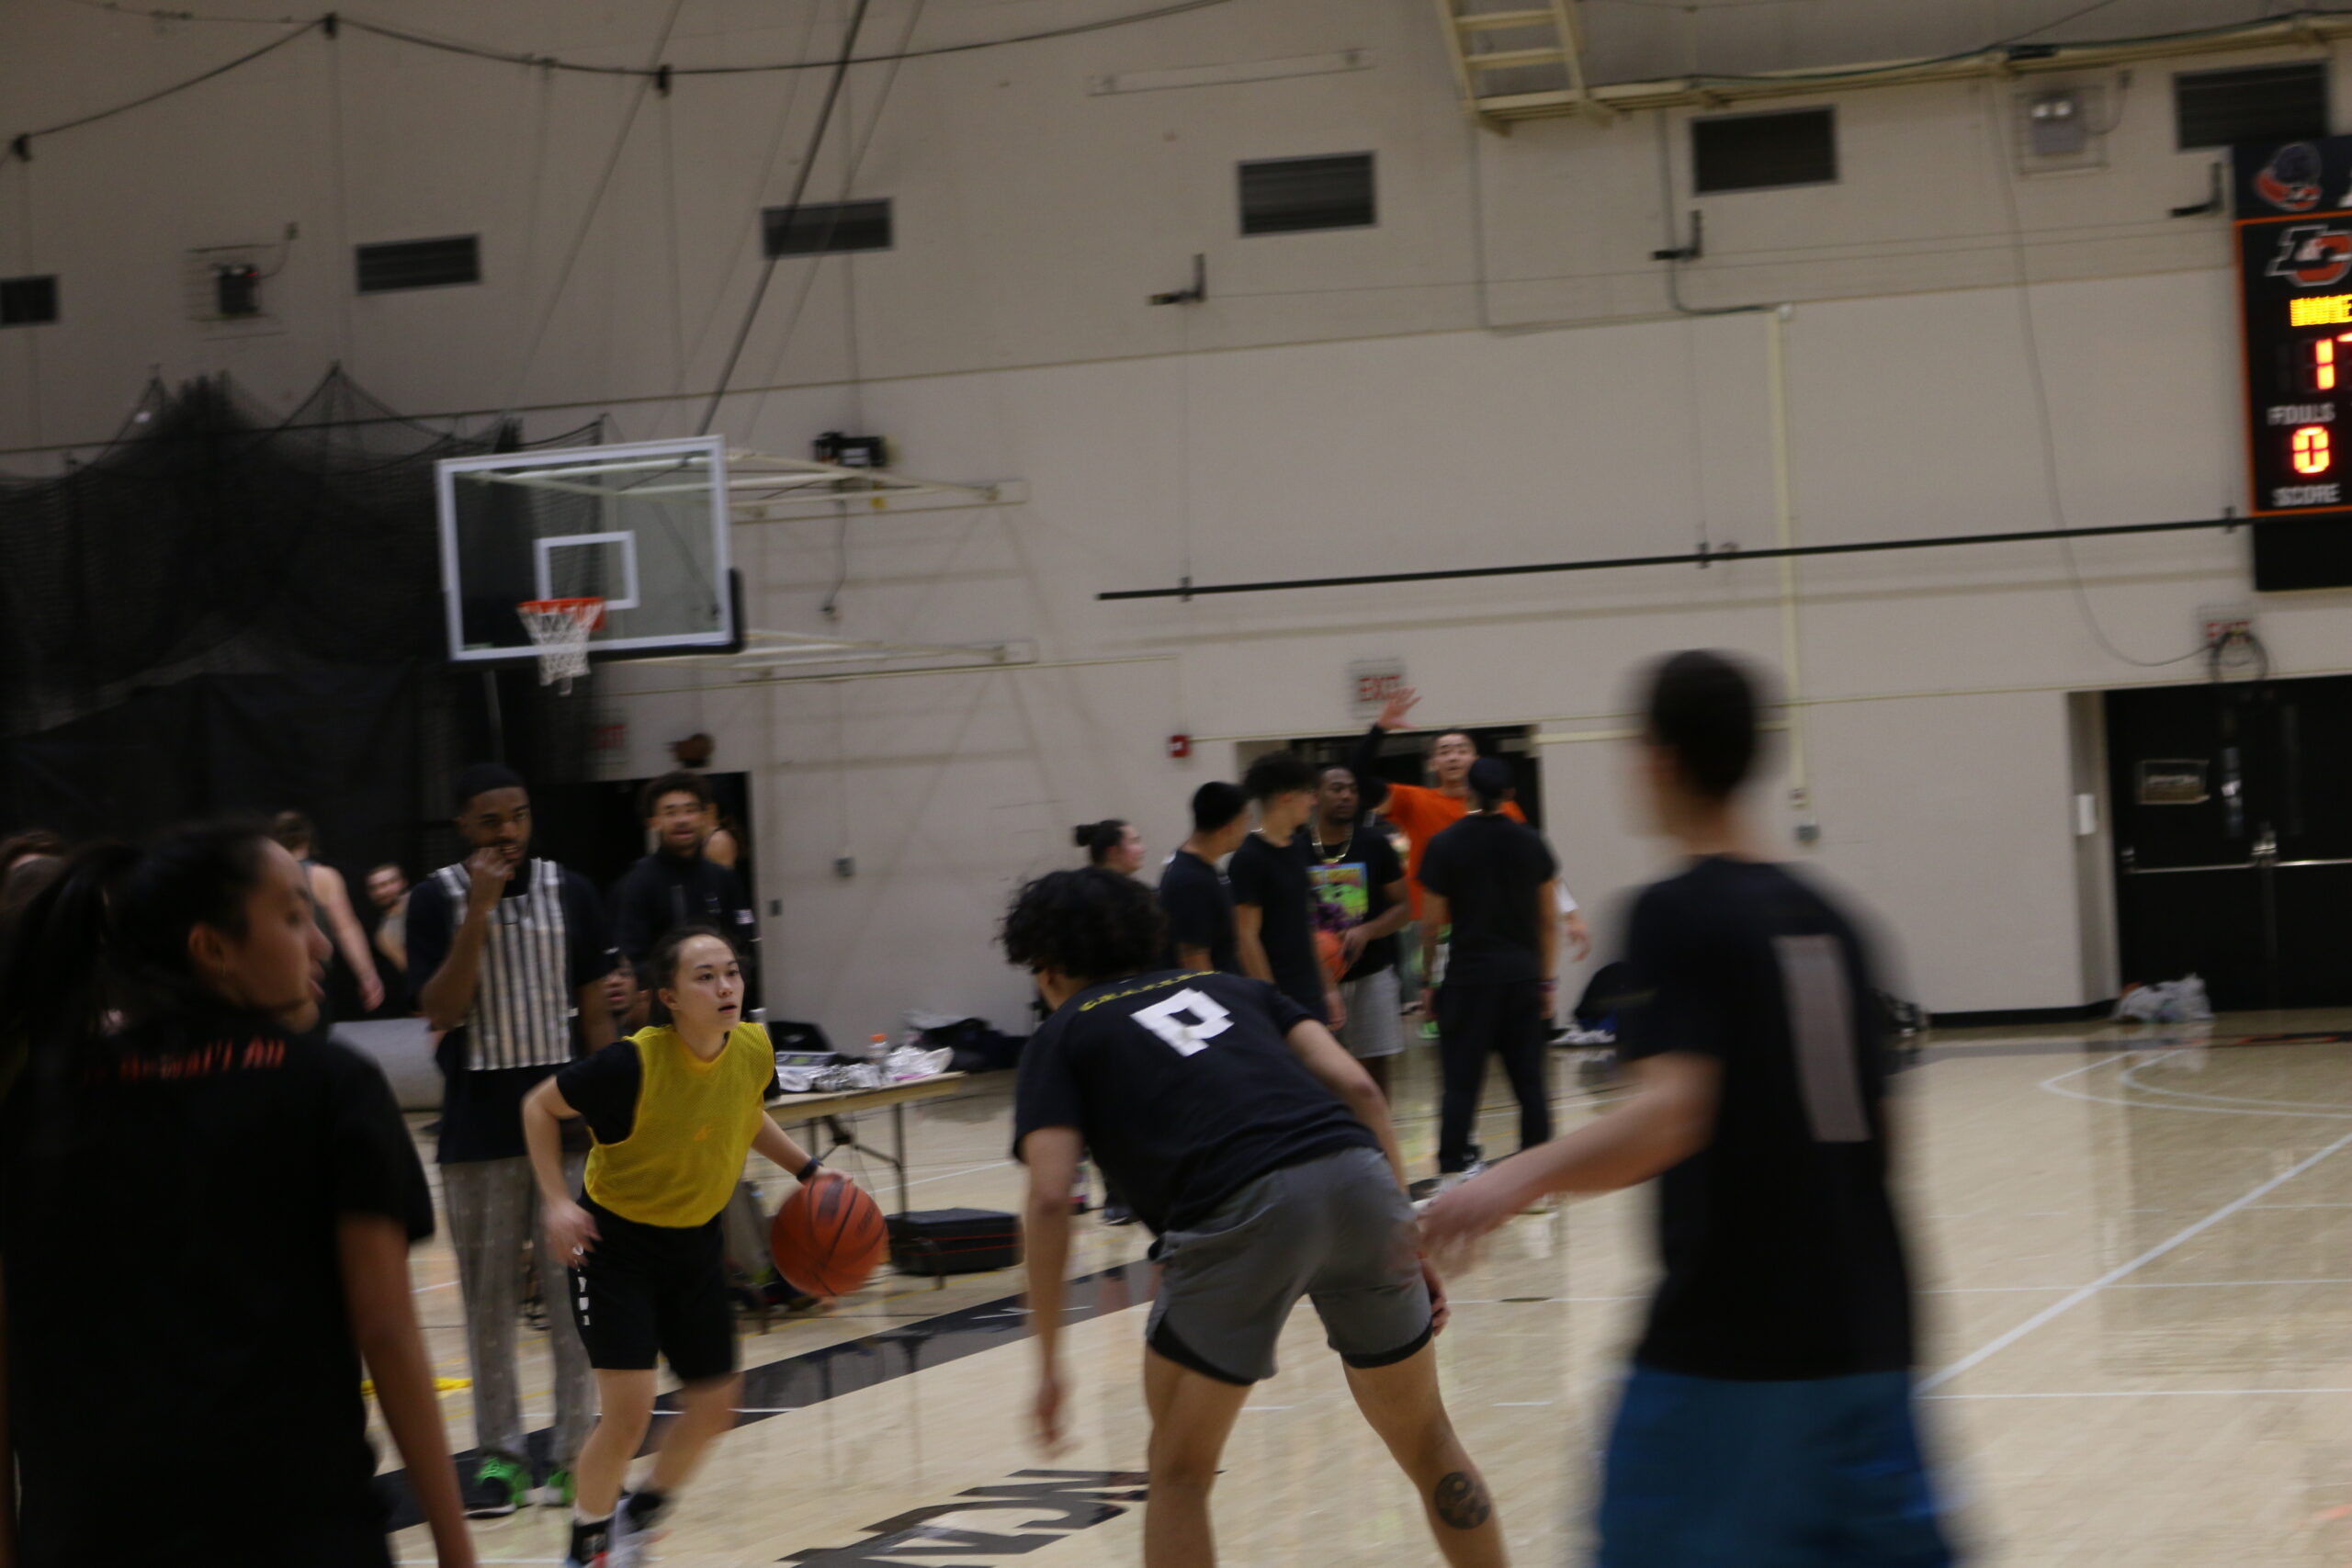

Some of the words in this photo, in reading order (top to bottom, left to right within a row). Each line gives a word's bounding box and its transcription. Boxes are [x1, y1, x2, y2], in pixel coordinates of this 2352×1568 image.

[2266, 401, 2335, 426] FOULS
[2291, 426, 2331, 474] 0
[2270, 481, 2341, 508] SCORE
